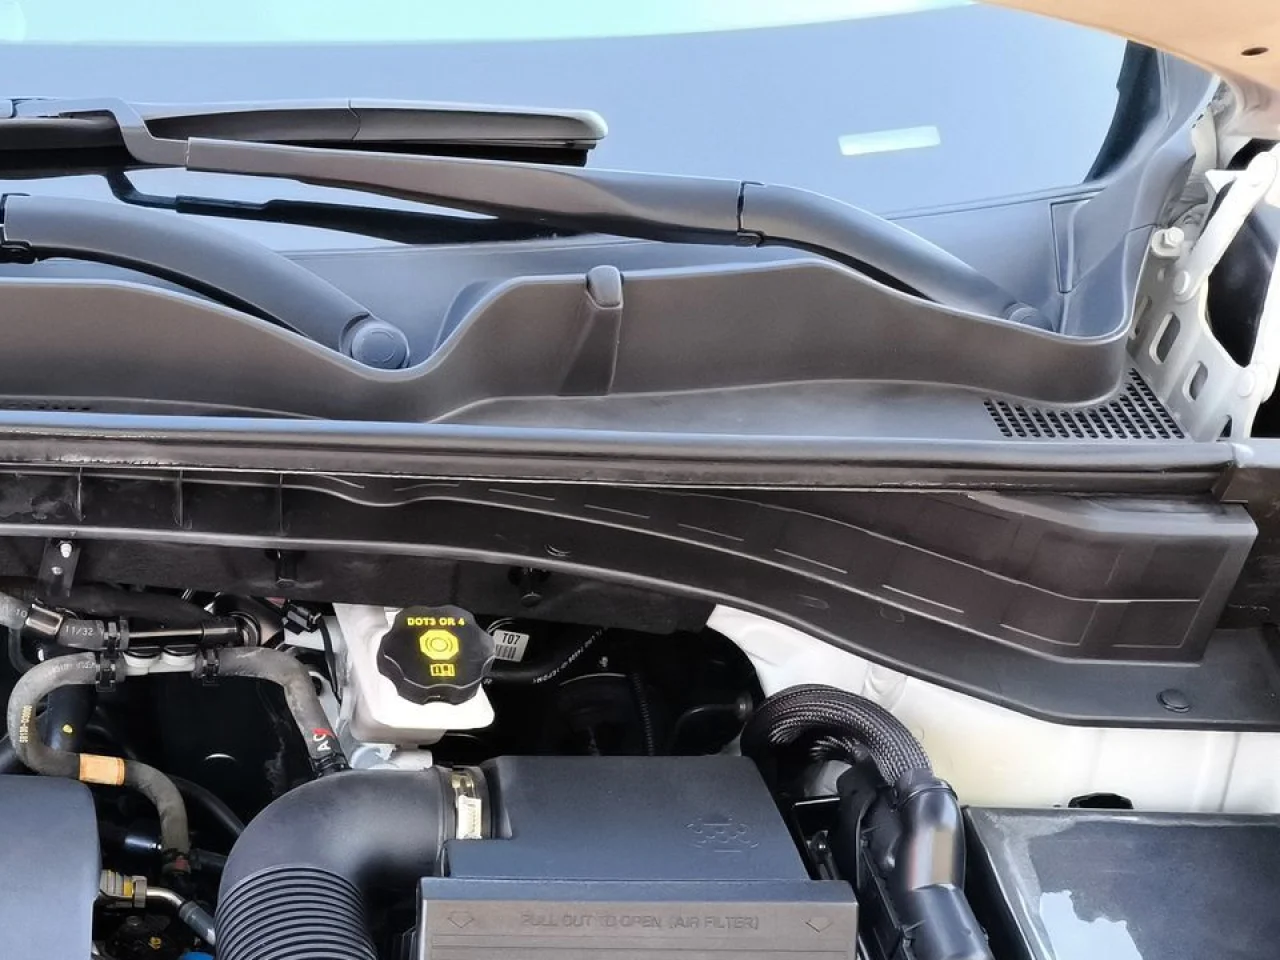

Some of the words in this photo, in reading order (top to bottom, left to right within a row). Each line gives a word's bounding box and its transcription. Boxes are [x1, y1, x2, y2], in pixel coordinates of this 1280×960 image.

[407, 617, 436, 626] DOT3
[439, 617, 455, 626] OR
[458, 617, 465, 626] 4
[65, 624, 94, 637] 11/32
[502, 632, 521, 645] T07
[522, 914, 558, 928] PULL
[562, 914, 593, 928] OUT
[597, 915, 617, 928] TO
[621, 915, 662, 929] OPEN
[703, 916, 759, 930] FILTER)
